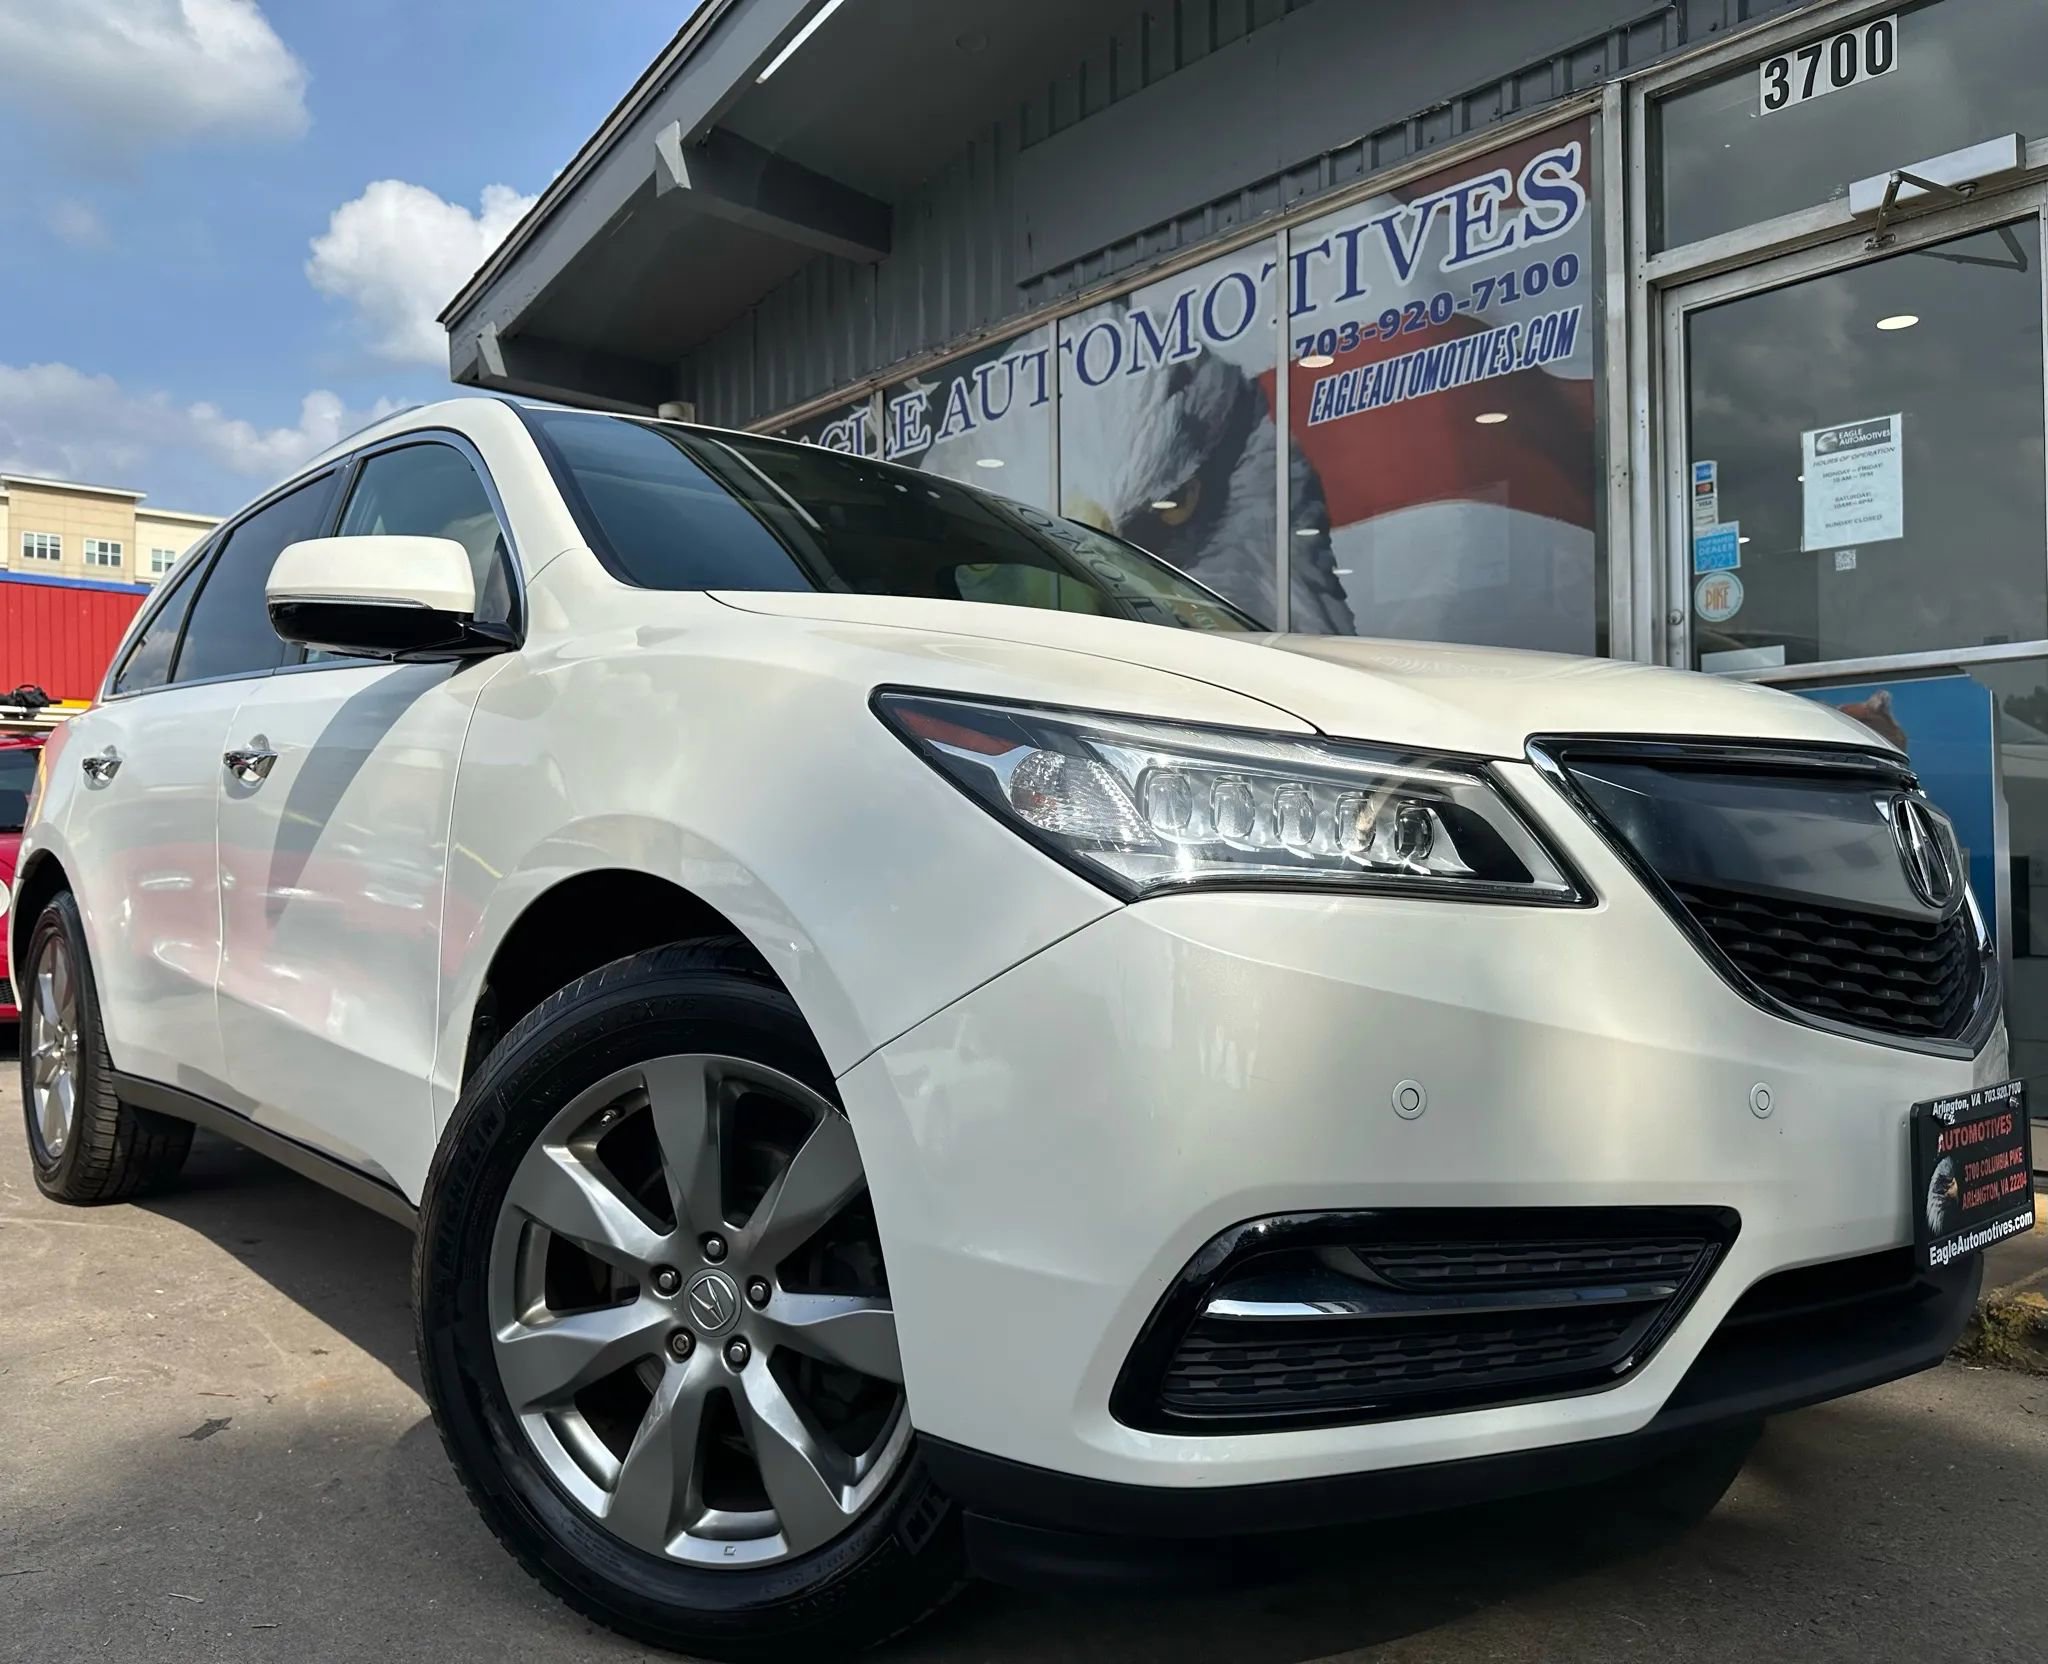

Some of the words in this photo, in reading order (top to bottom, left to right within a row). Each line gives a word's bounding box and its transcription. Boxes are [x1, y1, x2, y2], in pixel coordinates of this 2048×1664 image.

[1764, 20, 1893, 110] 3700
[936, 142, 1585, 442] AUTOMOTIVES
[1296, 254, 1580, 358] 703-920-7100
[1308, 306, 1583, 426] EAGLEAUTOMOTIVES.COM
[1838, 428, 1863, 440] EAGLE
[1838, 429, 1892, 446] AUTOMOTIVES
[1812, 457, 1839, 468] HOURS
[1839, 454, 1850, 463] OF
[1851, 446, 1896, 460] OPERATION
[1822, 468, 1851, 479] MONDAY
[1854, 514, 1883, 524] CLOSED
[1698, 543, 1735, 556] DEALER
[1932, 1098, 1969, 1117] Arlington,
[1970, 1093, 1981, 1107] VA
[1984, 1081, 2022, 1104] 703.920.7100
[1938, 1113, 2013, 1152] AUTOMOTIVES
[1964, 1161, 1980, 1182] 3700
[1980, 1151, 2010, 1177] COLUMBIA
[2010, 1146, 2023, 1166] PIKE
[2000, 1177, 2010, 1196] VA
[1929, 1210, 2033, 1266] EagleAutomotives.com
